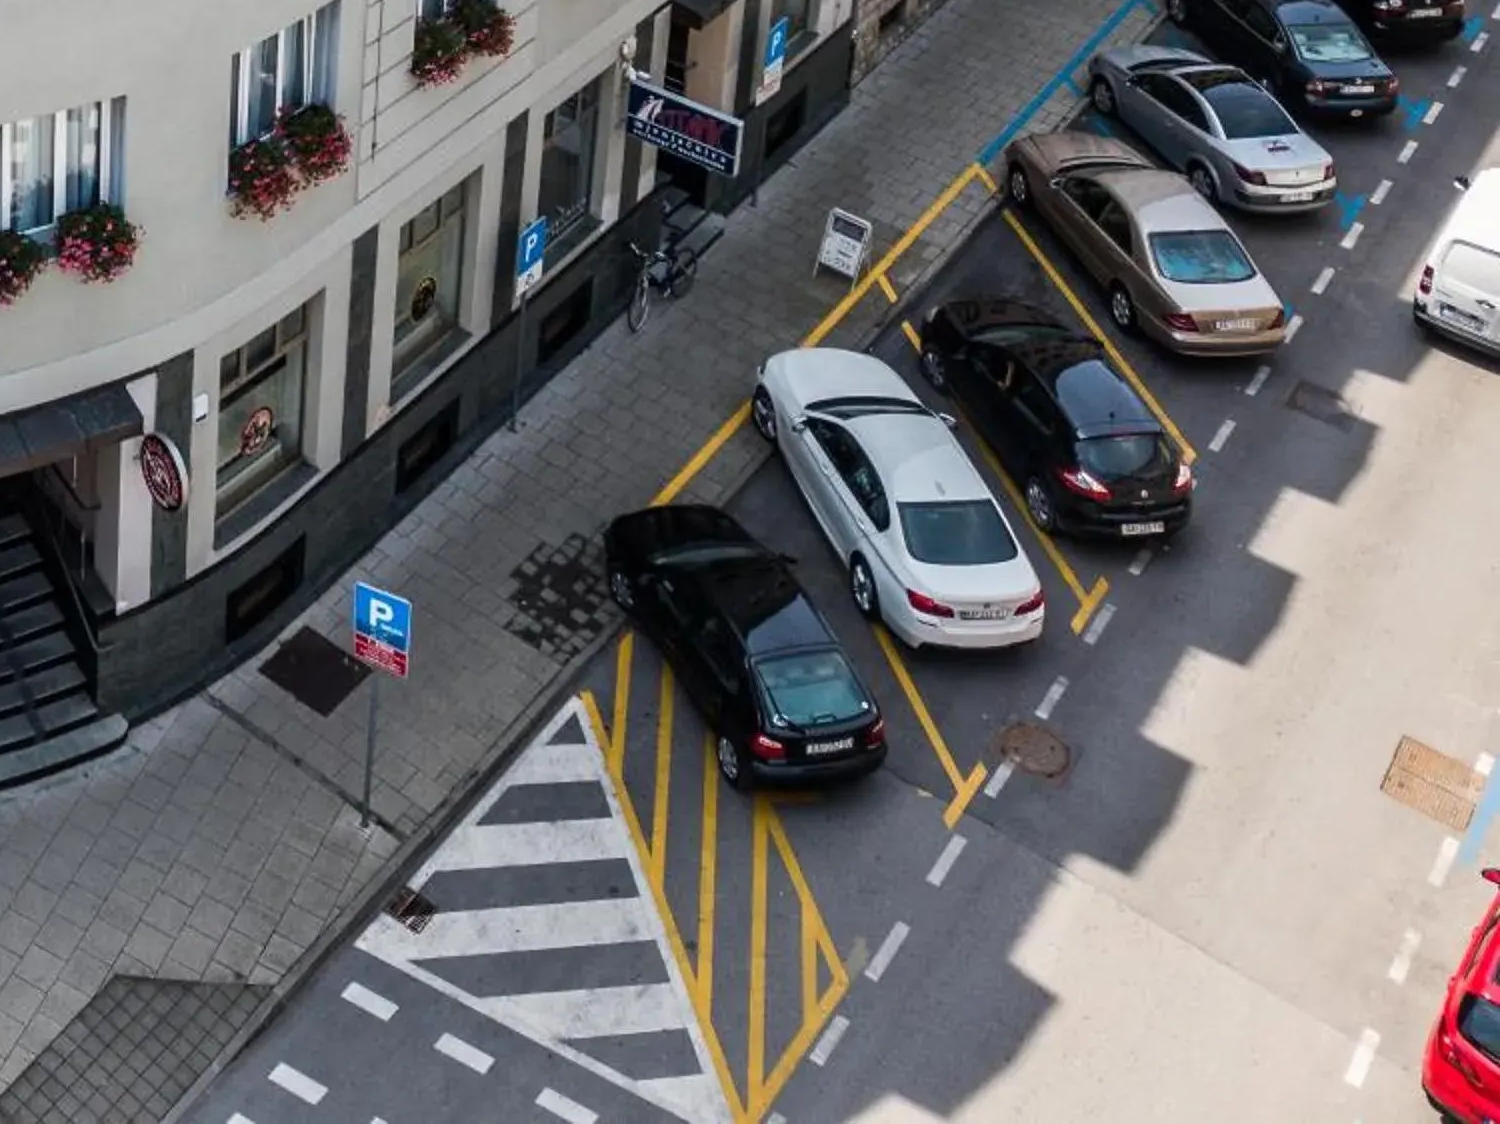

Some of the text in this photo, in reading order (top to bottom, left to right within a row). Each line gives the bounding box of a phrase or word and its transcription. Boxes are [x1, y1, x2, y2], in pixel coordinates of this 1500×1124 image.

[771, 31, 782, 57] P
[525, 233, 538, 263] P
[369, 597, 394, 626] P
